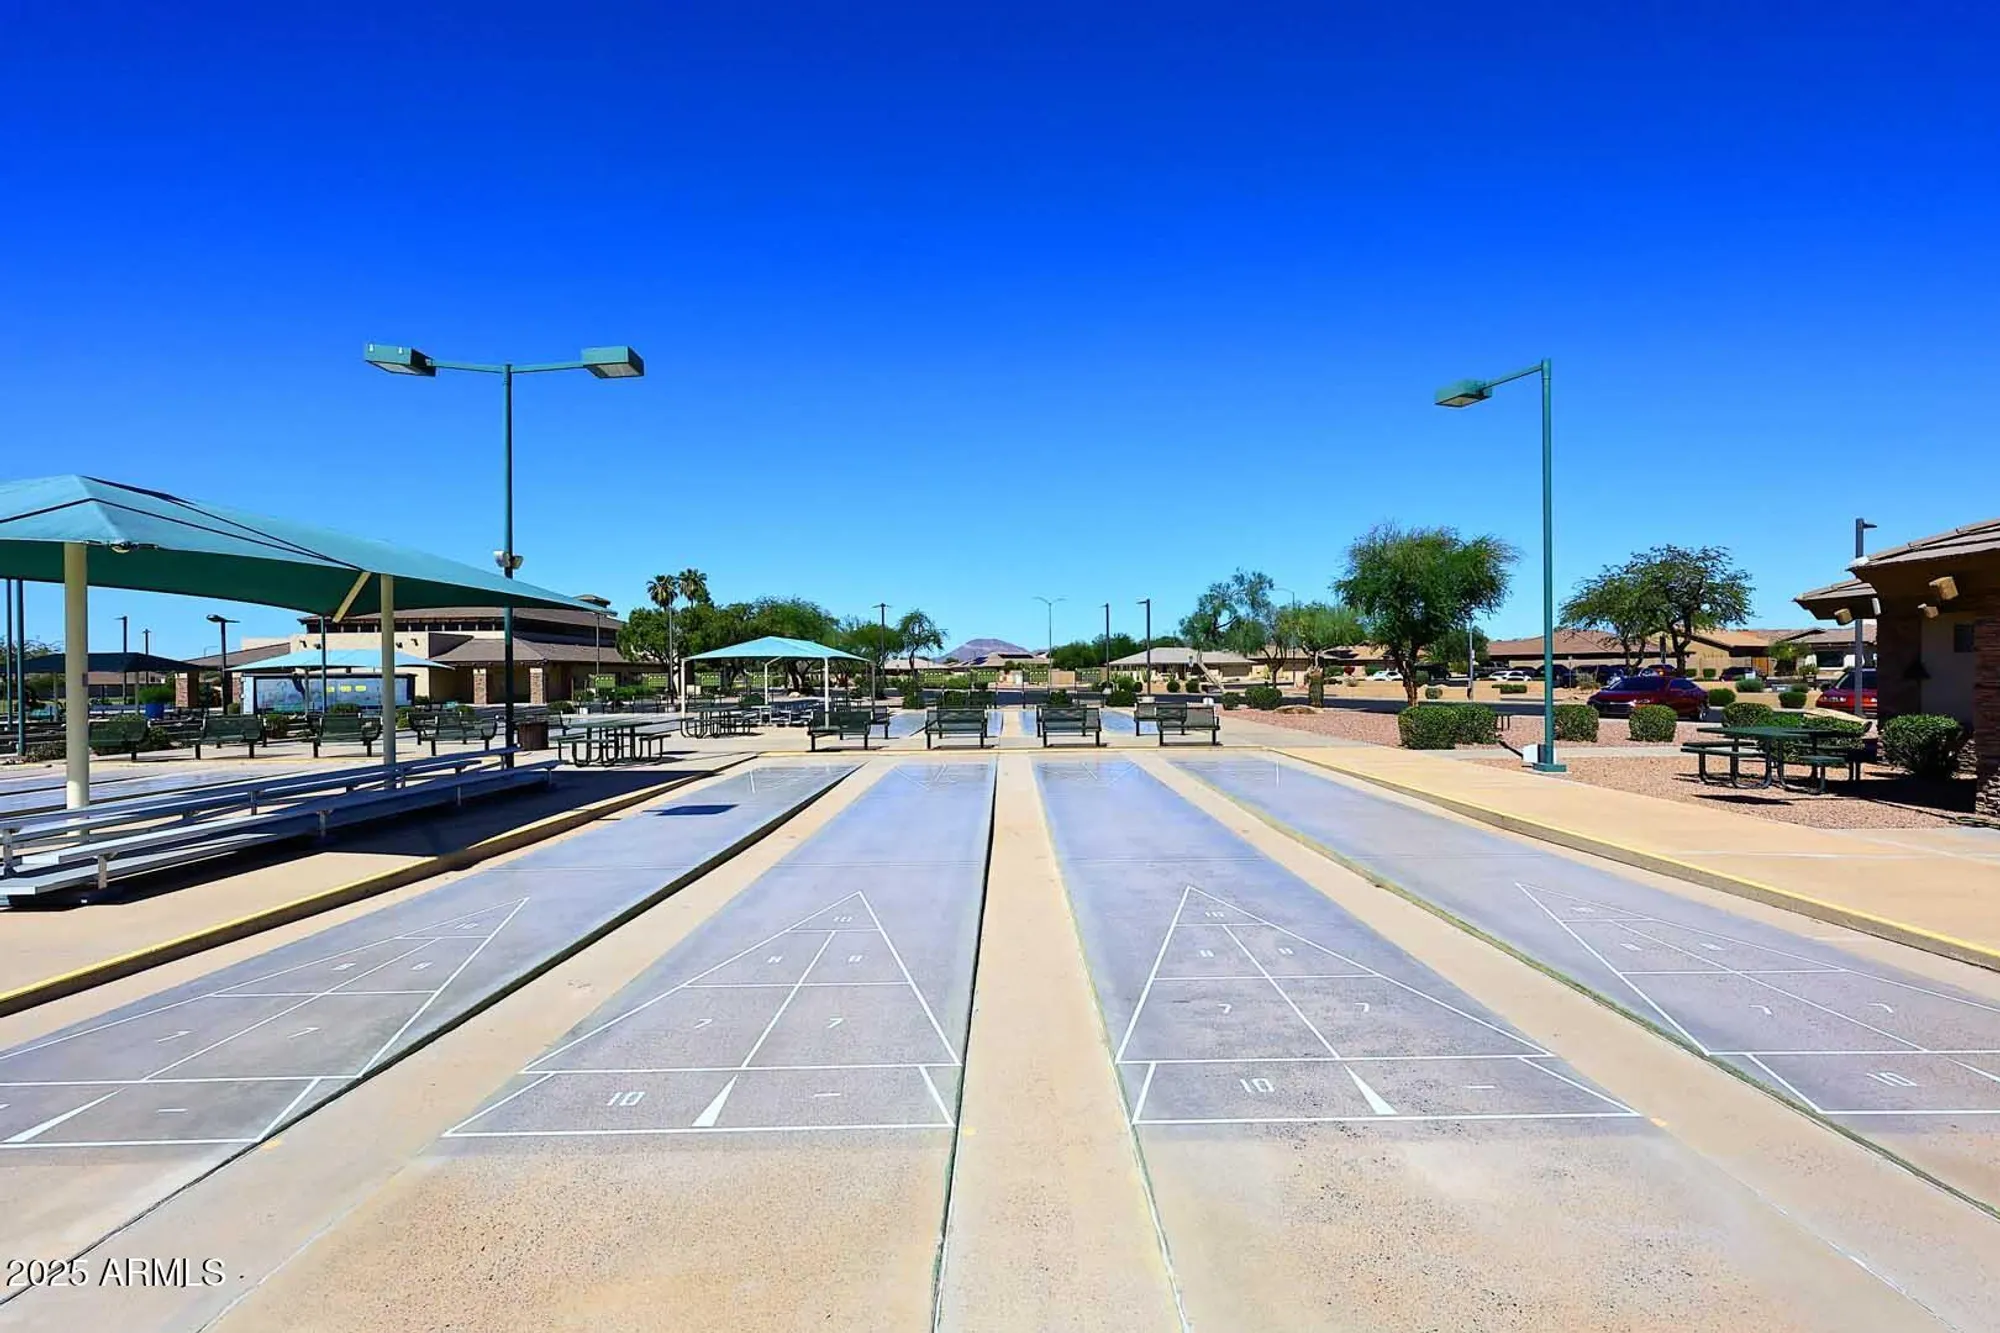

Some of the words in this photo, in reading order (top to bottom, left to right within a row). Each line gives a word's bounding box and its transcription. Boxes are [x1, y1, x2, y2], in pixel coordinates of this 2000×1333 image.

[1217, 1003, 1232, 1014] 7
[1354, 1002, 1370, 1013] 7
[694, 1018, 713, 1029] 7
[827, 1017, 844, 1029] 7
[1239, 1078, 1275, 1093] 10
[606, 1091, 646, 1107] 10
